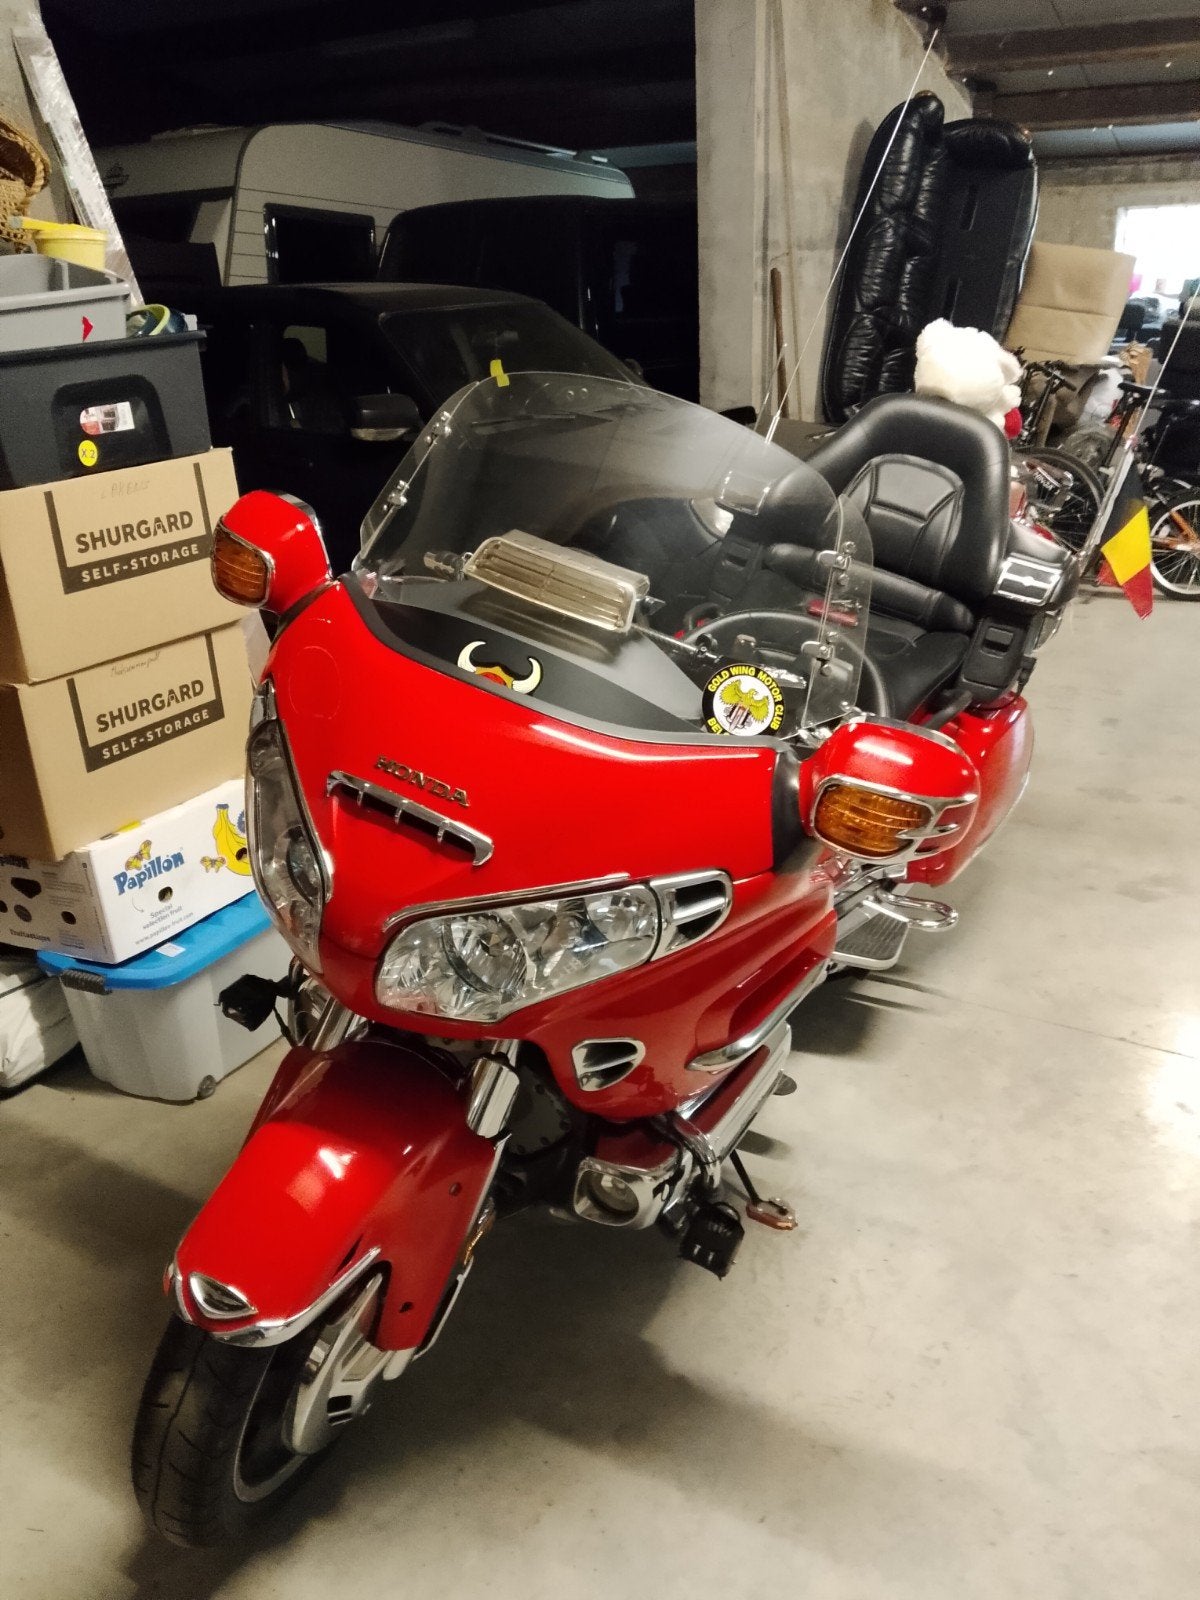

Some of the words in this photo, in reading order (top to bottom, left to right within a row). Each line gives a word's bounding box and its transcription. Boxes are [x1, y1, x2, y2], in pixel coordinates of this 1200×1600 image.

[75, 510, 194, 554] SHURGARD
[80, 544, 199, 583] SELF-STORAGE
[96, 679, 204, 733] SHURGARD
[708, 671, 729, 692] GOLD
[730, 666, 755, 676] WING
[757, 670, 783, 702] MOTOR
[771, 704, 784, 730] CLUB
[102, 709, 210, 760] SELF-STORAGE
[375, 755, 470, 807] HONDA
